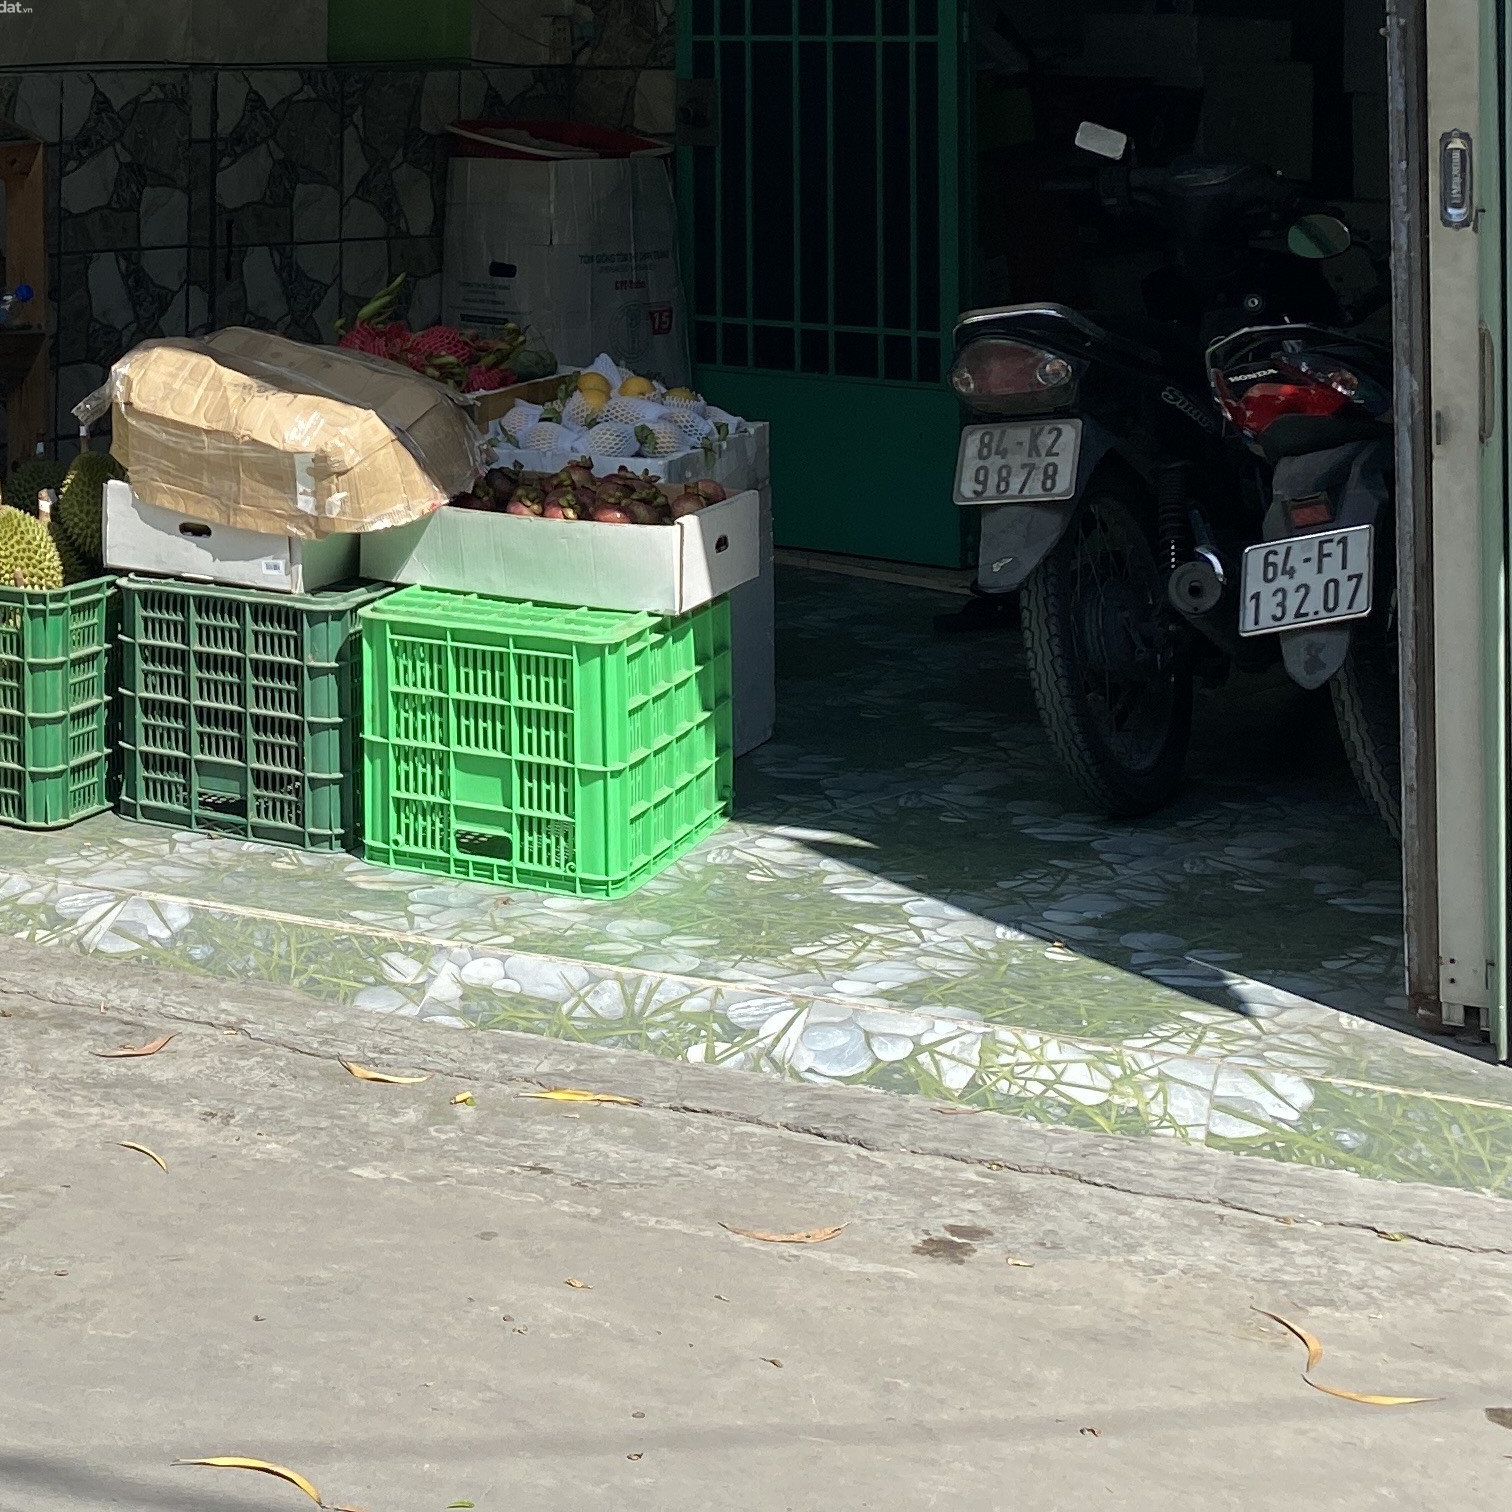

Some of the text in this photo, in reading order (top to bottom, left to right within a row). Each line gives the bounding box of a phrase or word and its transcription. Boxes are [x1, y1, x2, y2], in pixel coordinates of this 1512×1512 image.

[1228, 368, 1279, 383] HONDA
[976, 426, 1064, 461] 84-K2
[972, 461, 1059, 497] 9878
[1262, 535, 1350, 584] 64-F1
[1249, 572, 1364, 627] 132.07
